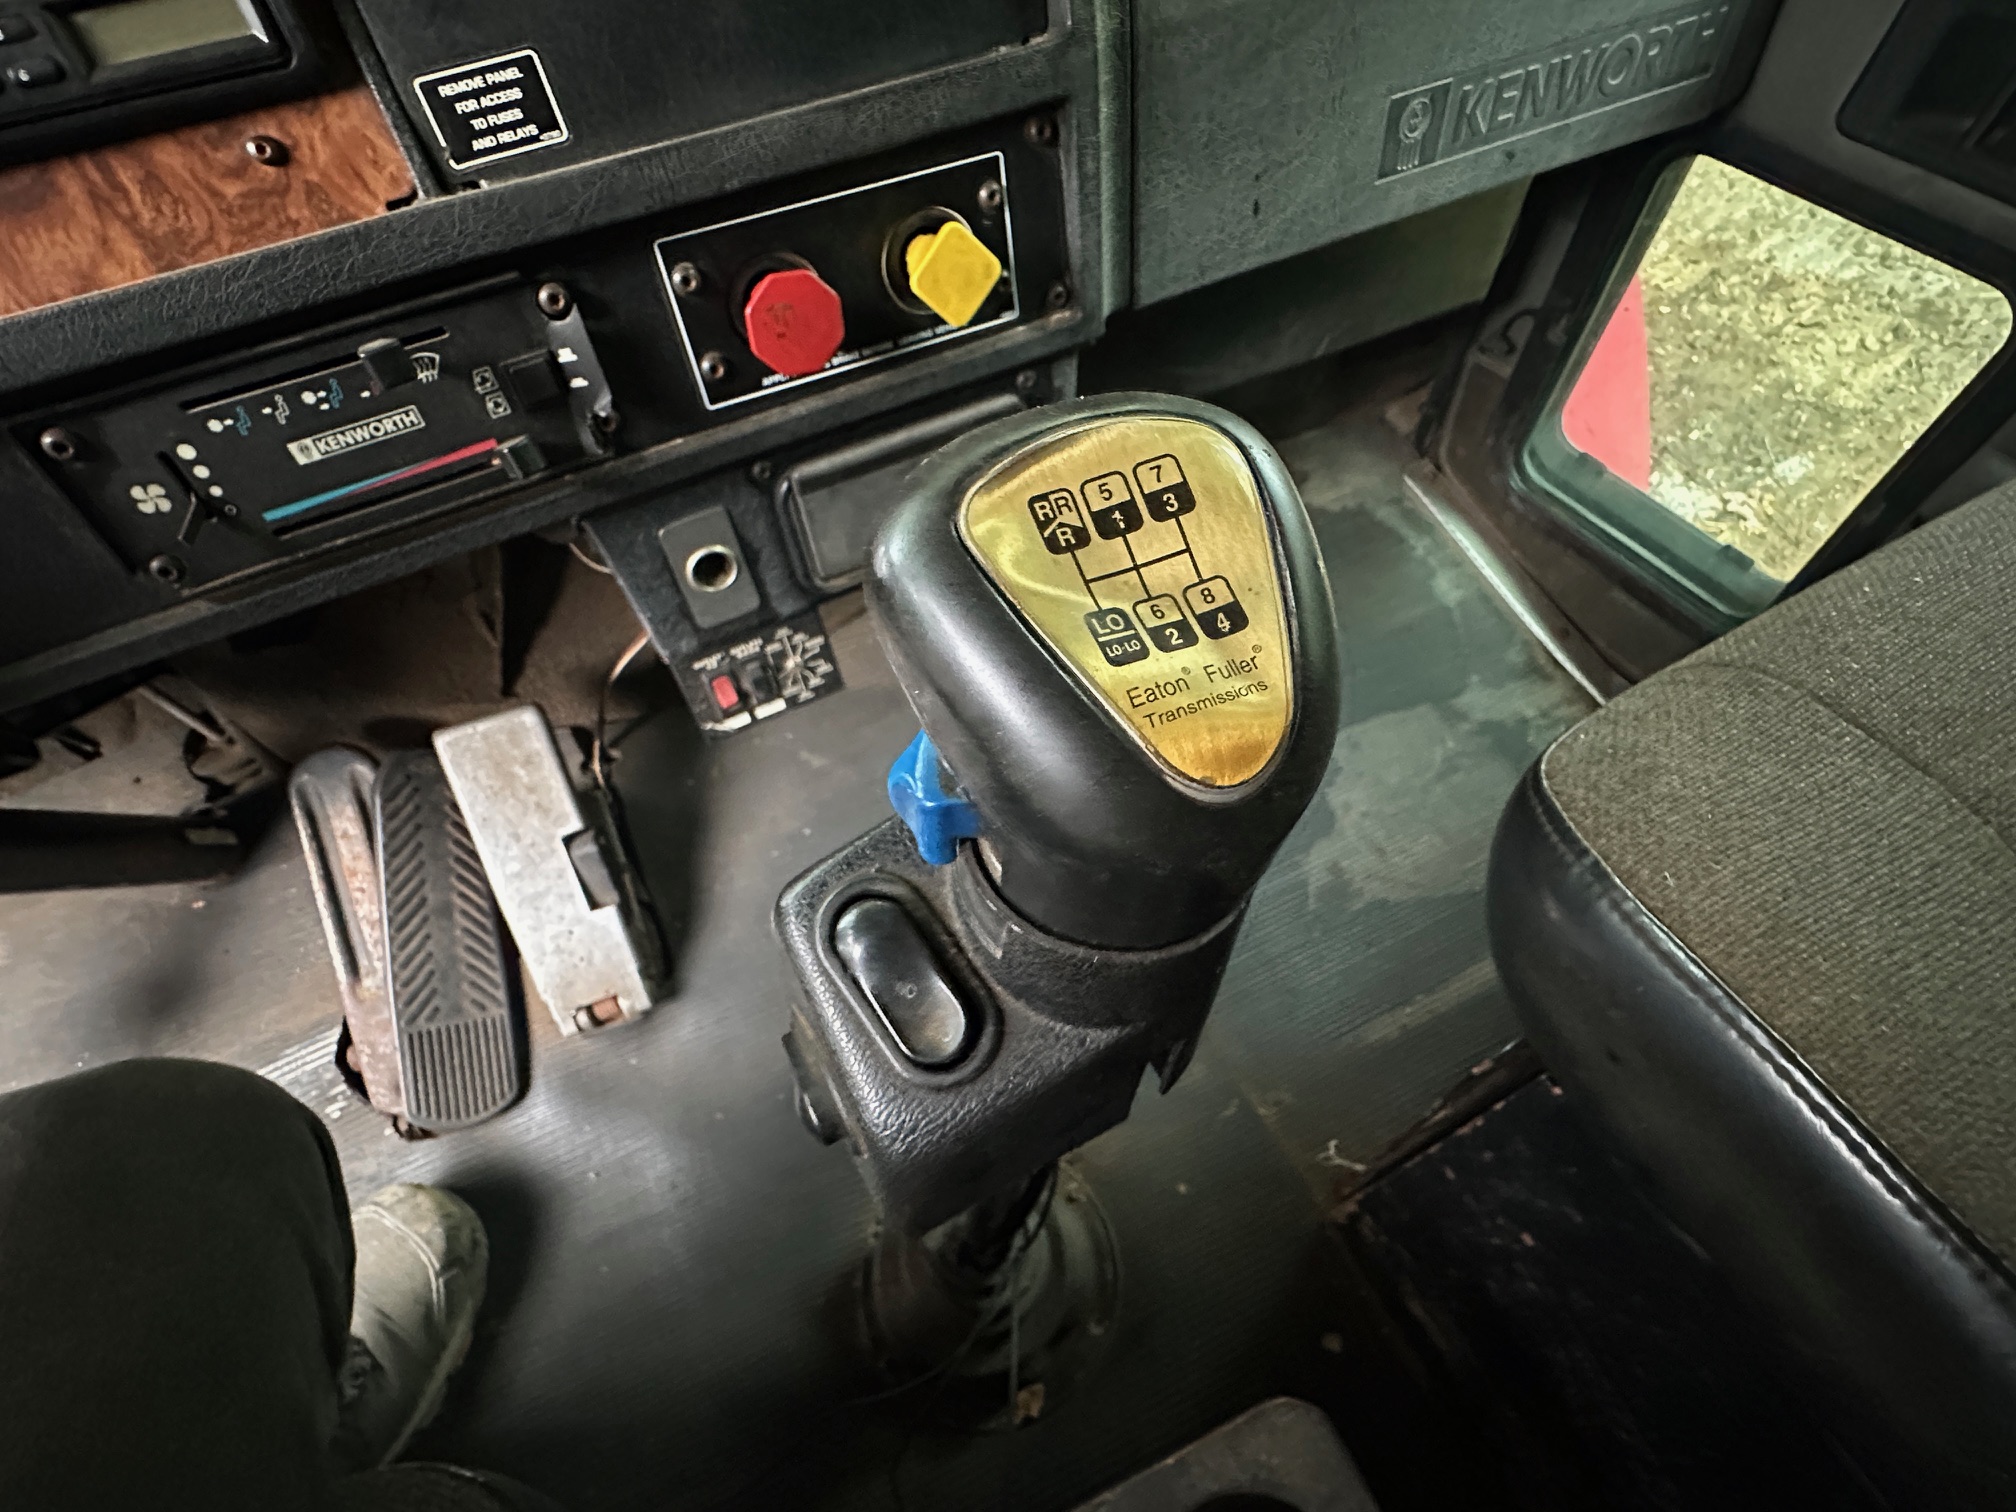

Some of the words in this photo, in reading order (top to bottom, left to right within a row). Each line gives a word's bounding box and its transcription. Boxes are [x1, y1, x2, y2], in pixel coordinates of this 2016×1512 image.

[437, 75, 487, 98] REMOVE
[485, 66, 524, 86] PANEL
[1452, 5, 1729, 147] KENWORTH
[454, 98, 480, 115] FOR
[480, 87, 523, 108] ACCESS
[469, 117, 488, 131] TO
[486, 107, 524, 127] FUSES
[471, 135, 498, 152] AND
[496, 124, 540, 145] RELAYS
[315, 410, 419, 454] KENWORTH
[1149, 464, 1162, 483] 7
[1098, 482, 1113, 501] 5
[1162, 493, 1179, 512] 3
[1056, 527, 1076, 547] R
[1200, 587, 1216, 604] 8
[1150, 604, 1166, 620] 6
[1217, 612, 1231, 633] 4
[1090, 613, 1125, 635] LO
[1165, 628, 1184, 646] 2
[1105, 639, 1141, 657] LO-LO
[1143, 680, 1268, 728] Transmissions
